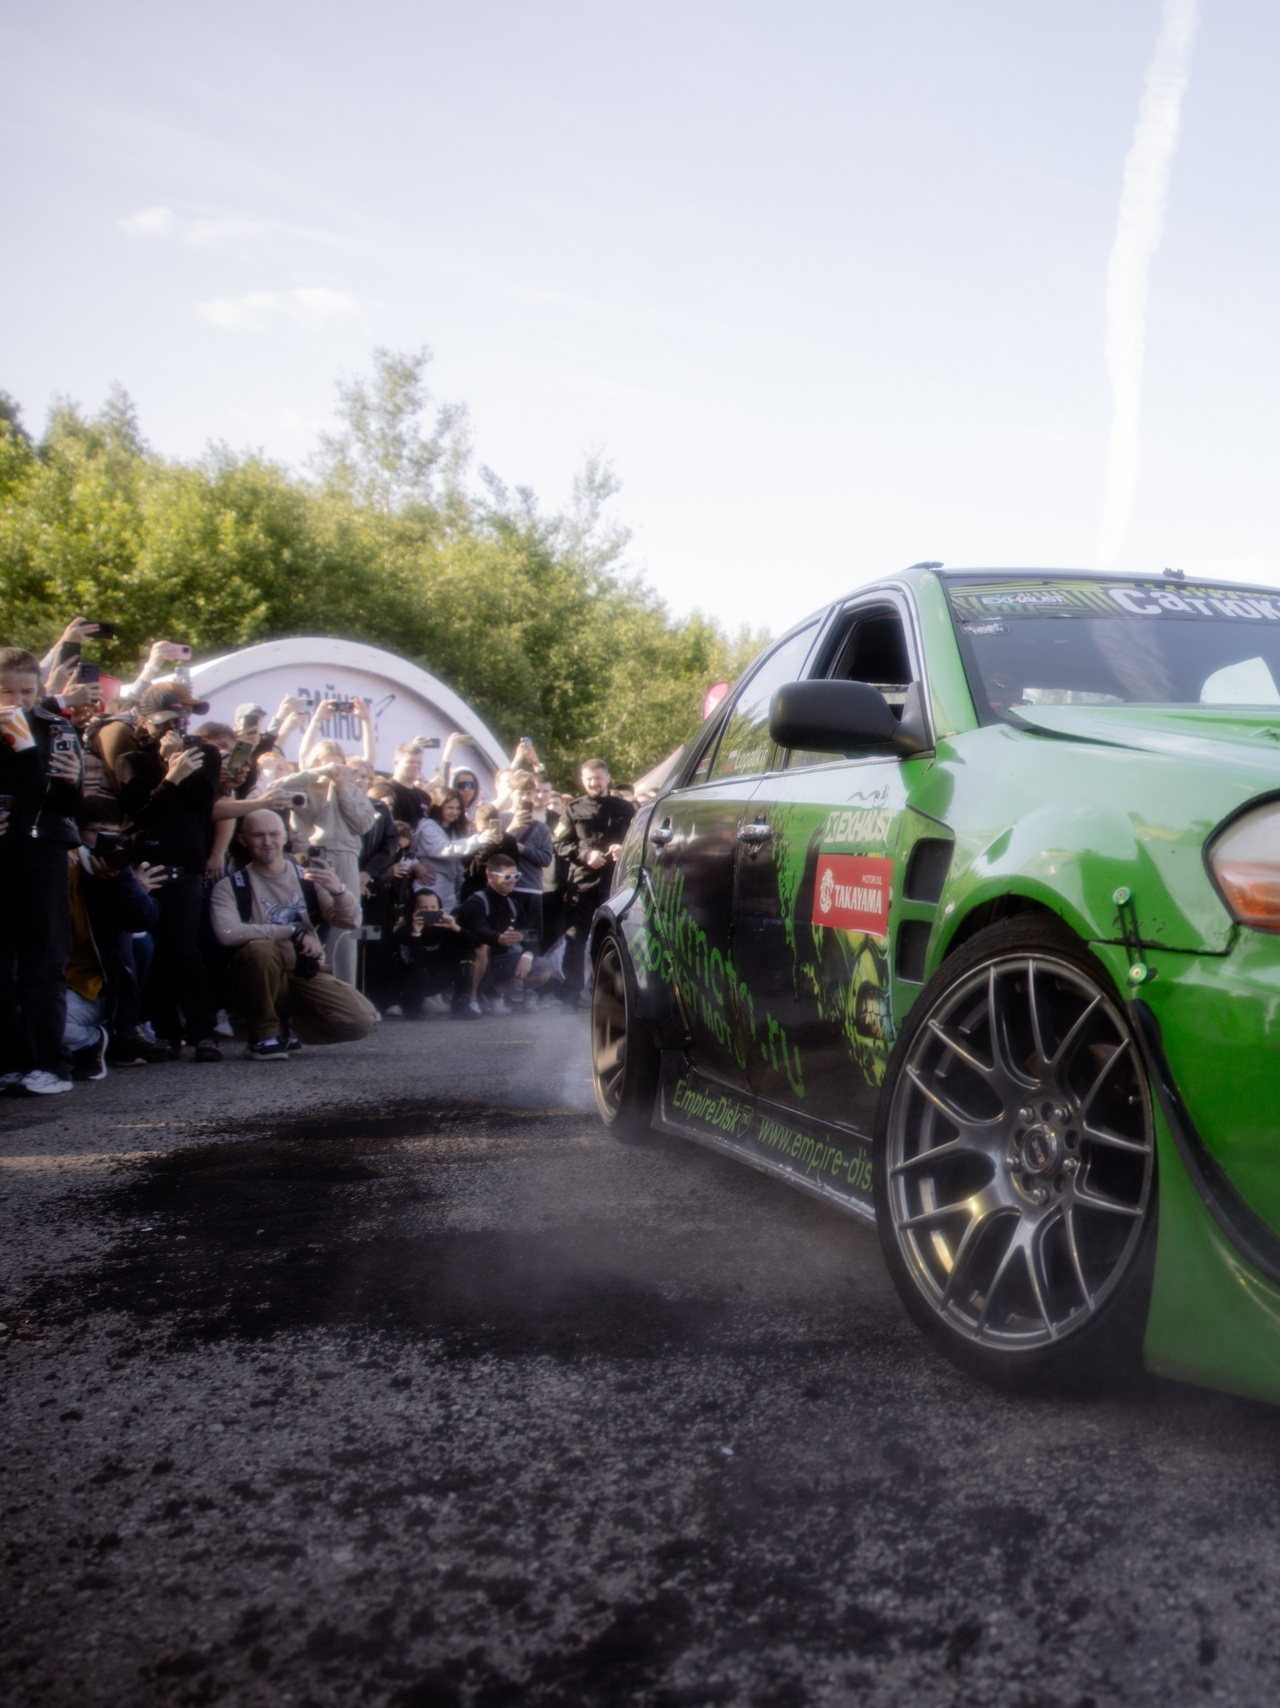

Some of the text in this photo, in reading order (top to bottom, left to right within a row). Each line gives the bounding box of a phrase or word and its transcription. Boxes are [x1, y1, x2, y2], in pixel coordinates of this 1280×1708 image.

[981, 595, 1065, 605] EXHAUST
[836, 809, 898, 843] EXHAUST
[834, 884, 882, 914] TAKAYAMA
[758, 1119, 873, 1192] www.empire-dis
